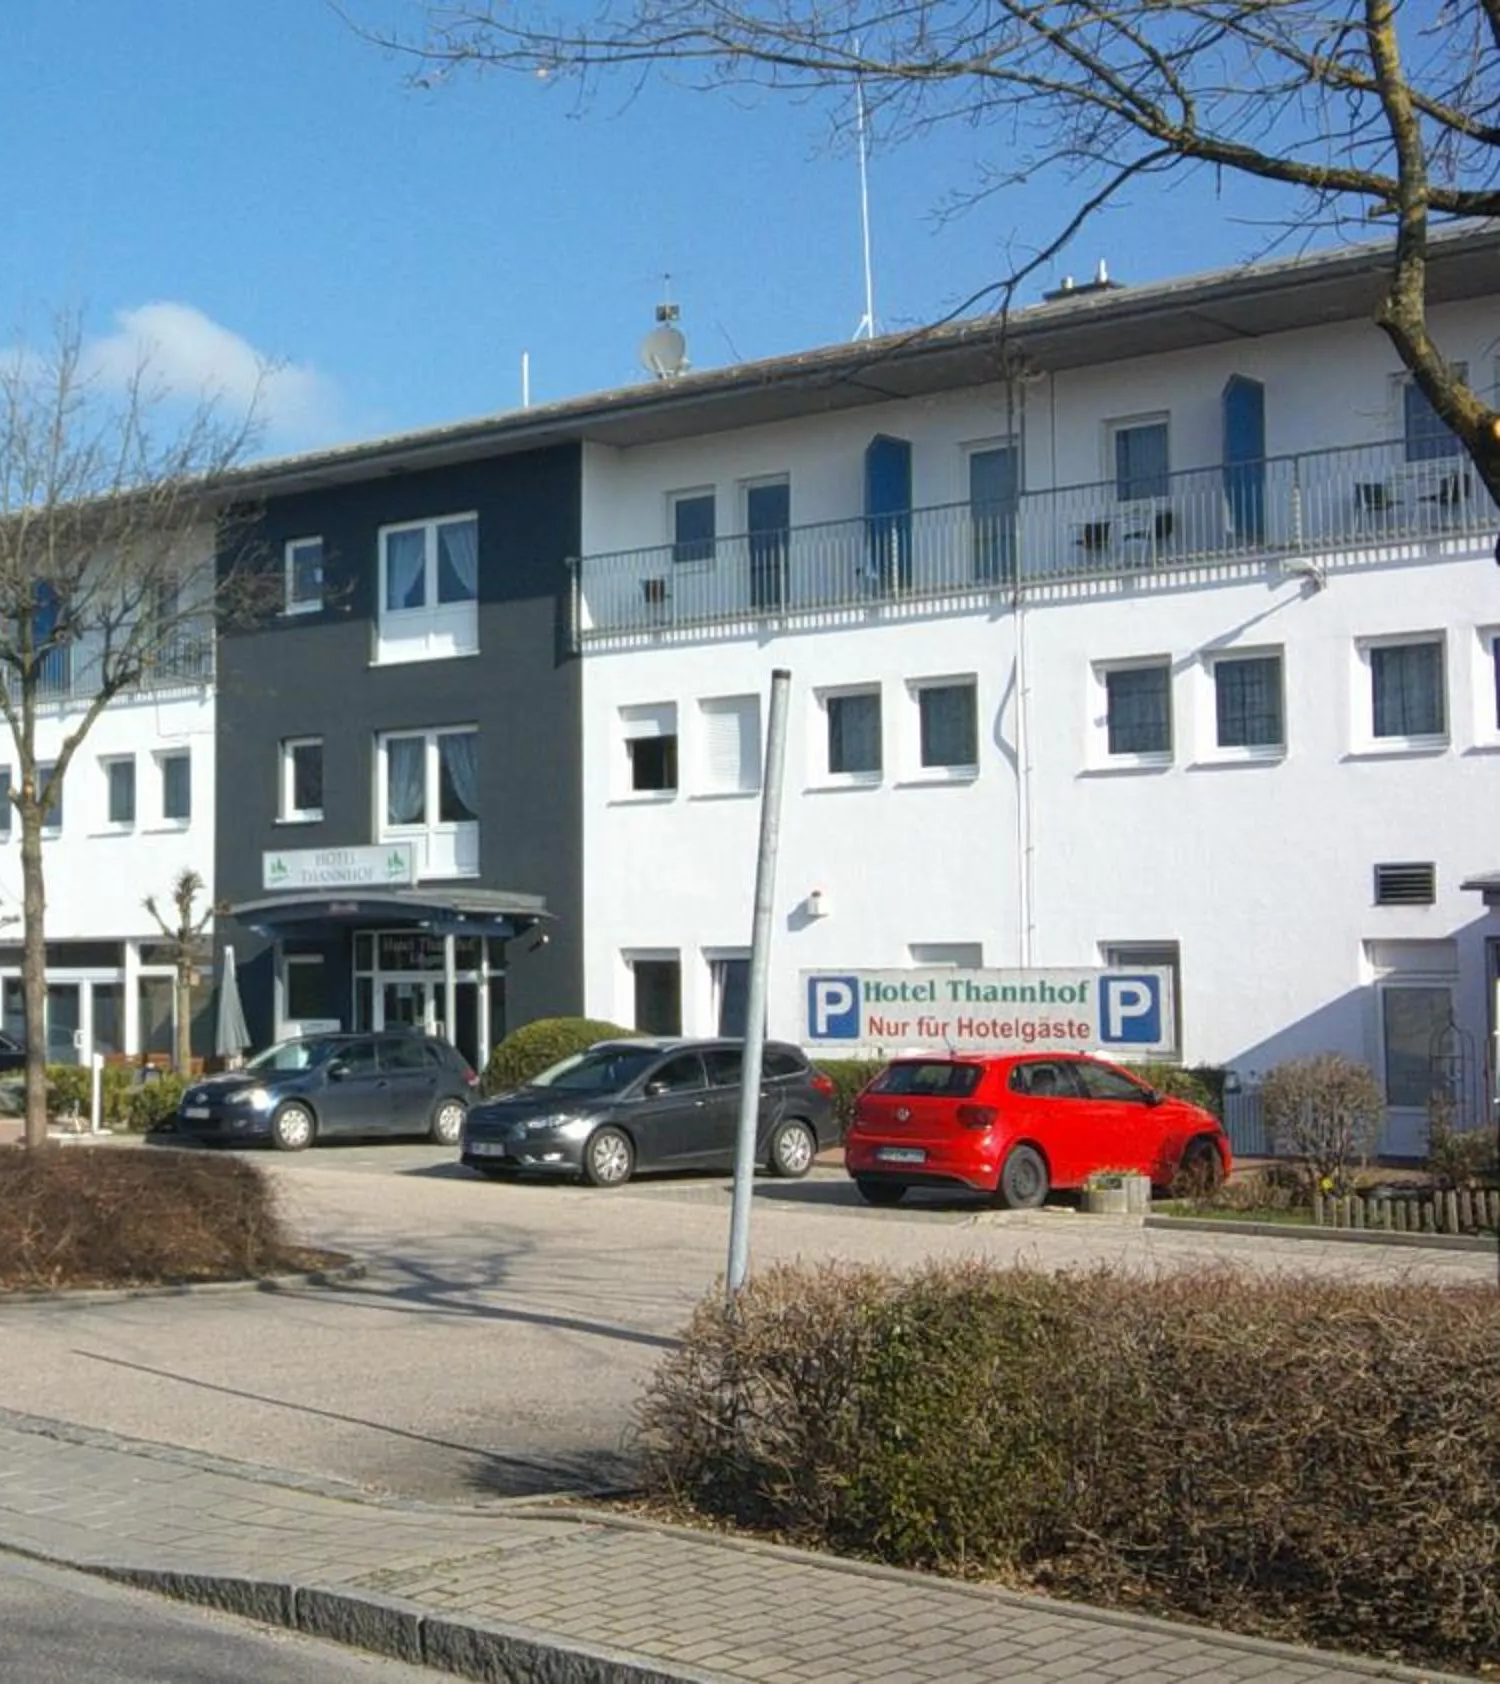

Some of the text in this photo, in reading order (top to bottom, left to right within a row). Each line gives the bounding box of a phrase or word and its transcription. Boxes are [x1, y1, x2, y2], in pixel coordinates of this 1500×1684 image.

[815, 981, 853, 1034] P
[863, 979, 1091, 1004] Hotel Thannhof
[1108, 980, 1153, 1038] P
[868, 1015, 1091, 1042] Nur für Hotelgäste
